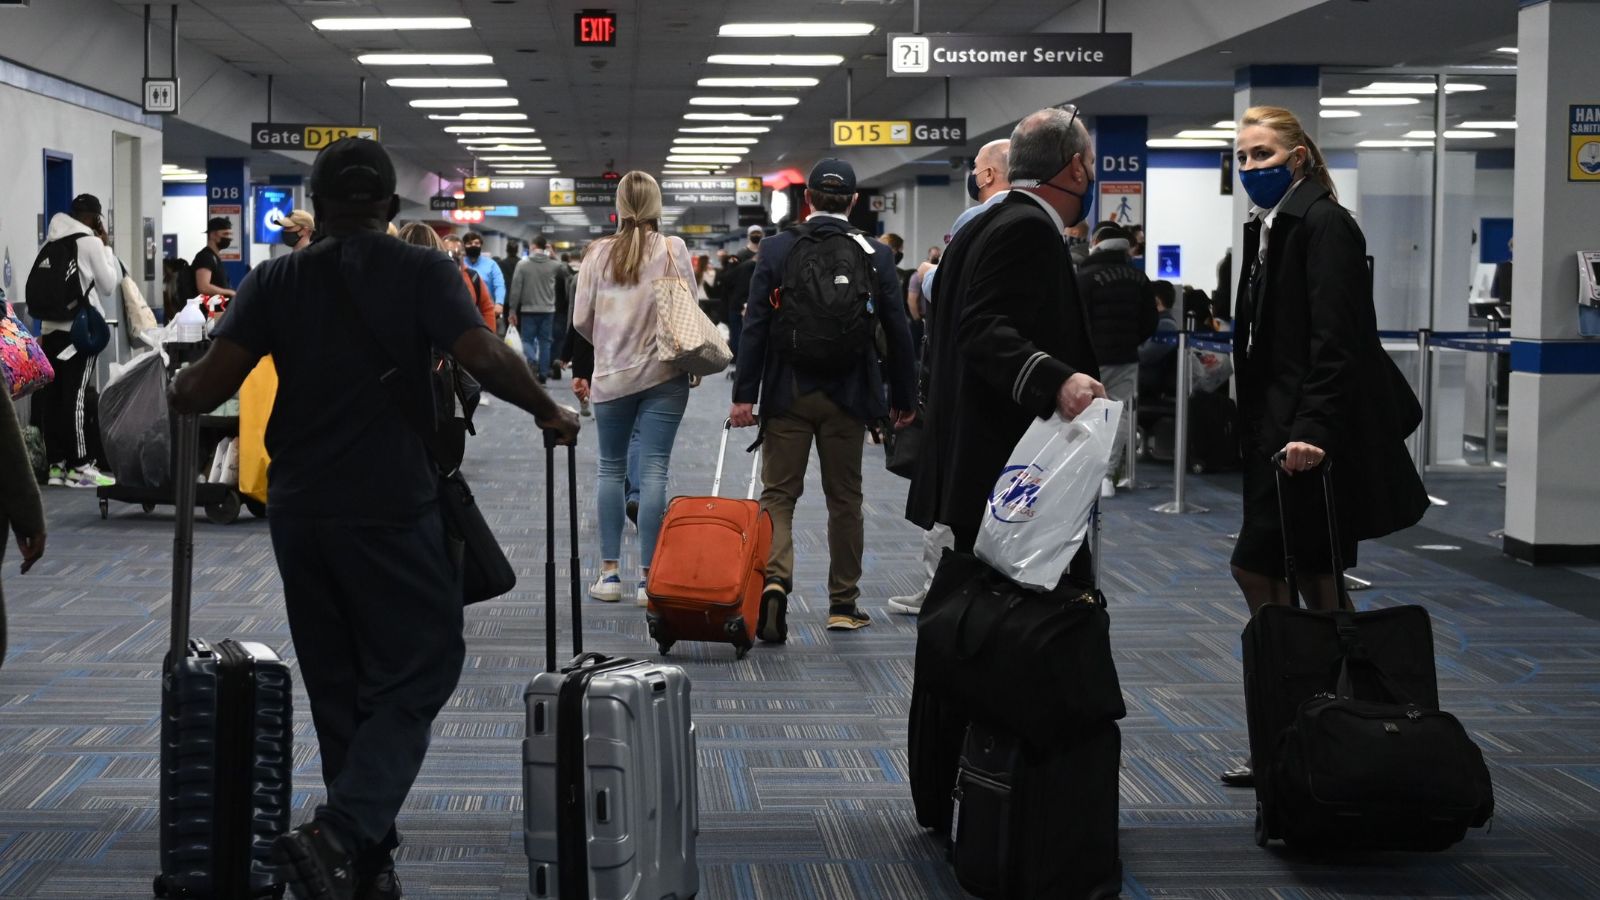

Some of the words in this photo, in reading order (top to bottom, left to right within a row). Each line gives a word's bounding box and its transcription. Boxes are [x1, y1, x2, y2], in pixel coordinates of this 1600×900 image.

[580, 17, 613, 42] EXIT
[932, 46, 1028, 63] Customer
[1033, 46, 1105, 63] Service
[256, 129, 301, 145] Gate
[837, 124, 881, 142] D15
[914, 124, 962, 141] Gate
[1102, 156, 1140, 173] D15
[211, 187, 239, 199] D18
[432, 199, 456, 208] Gate
